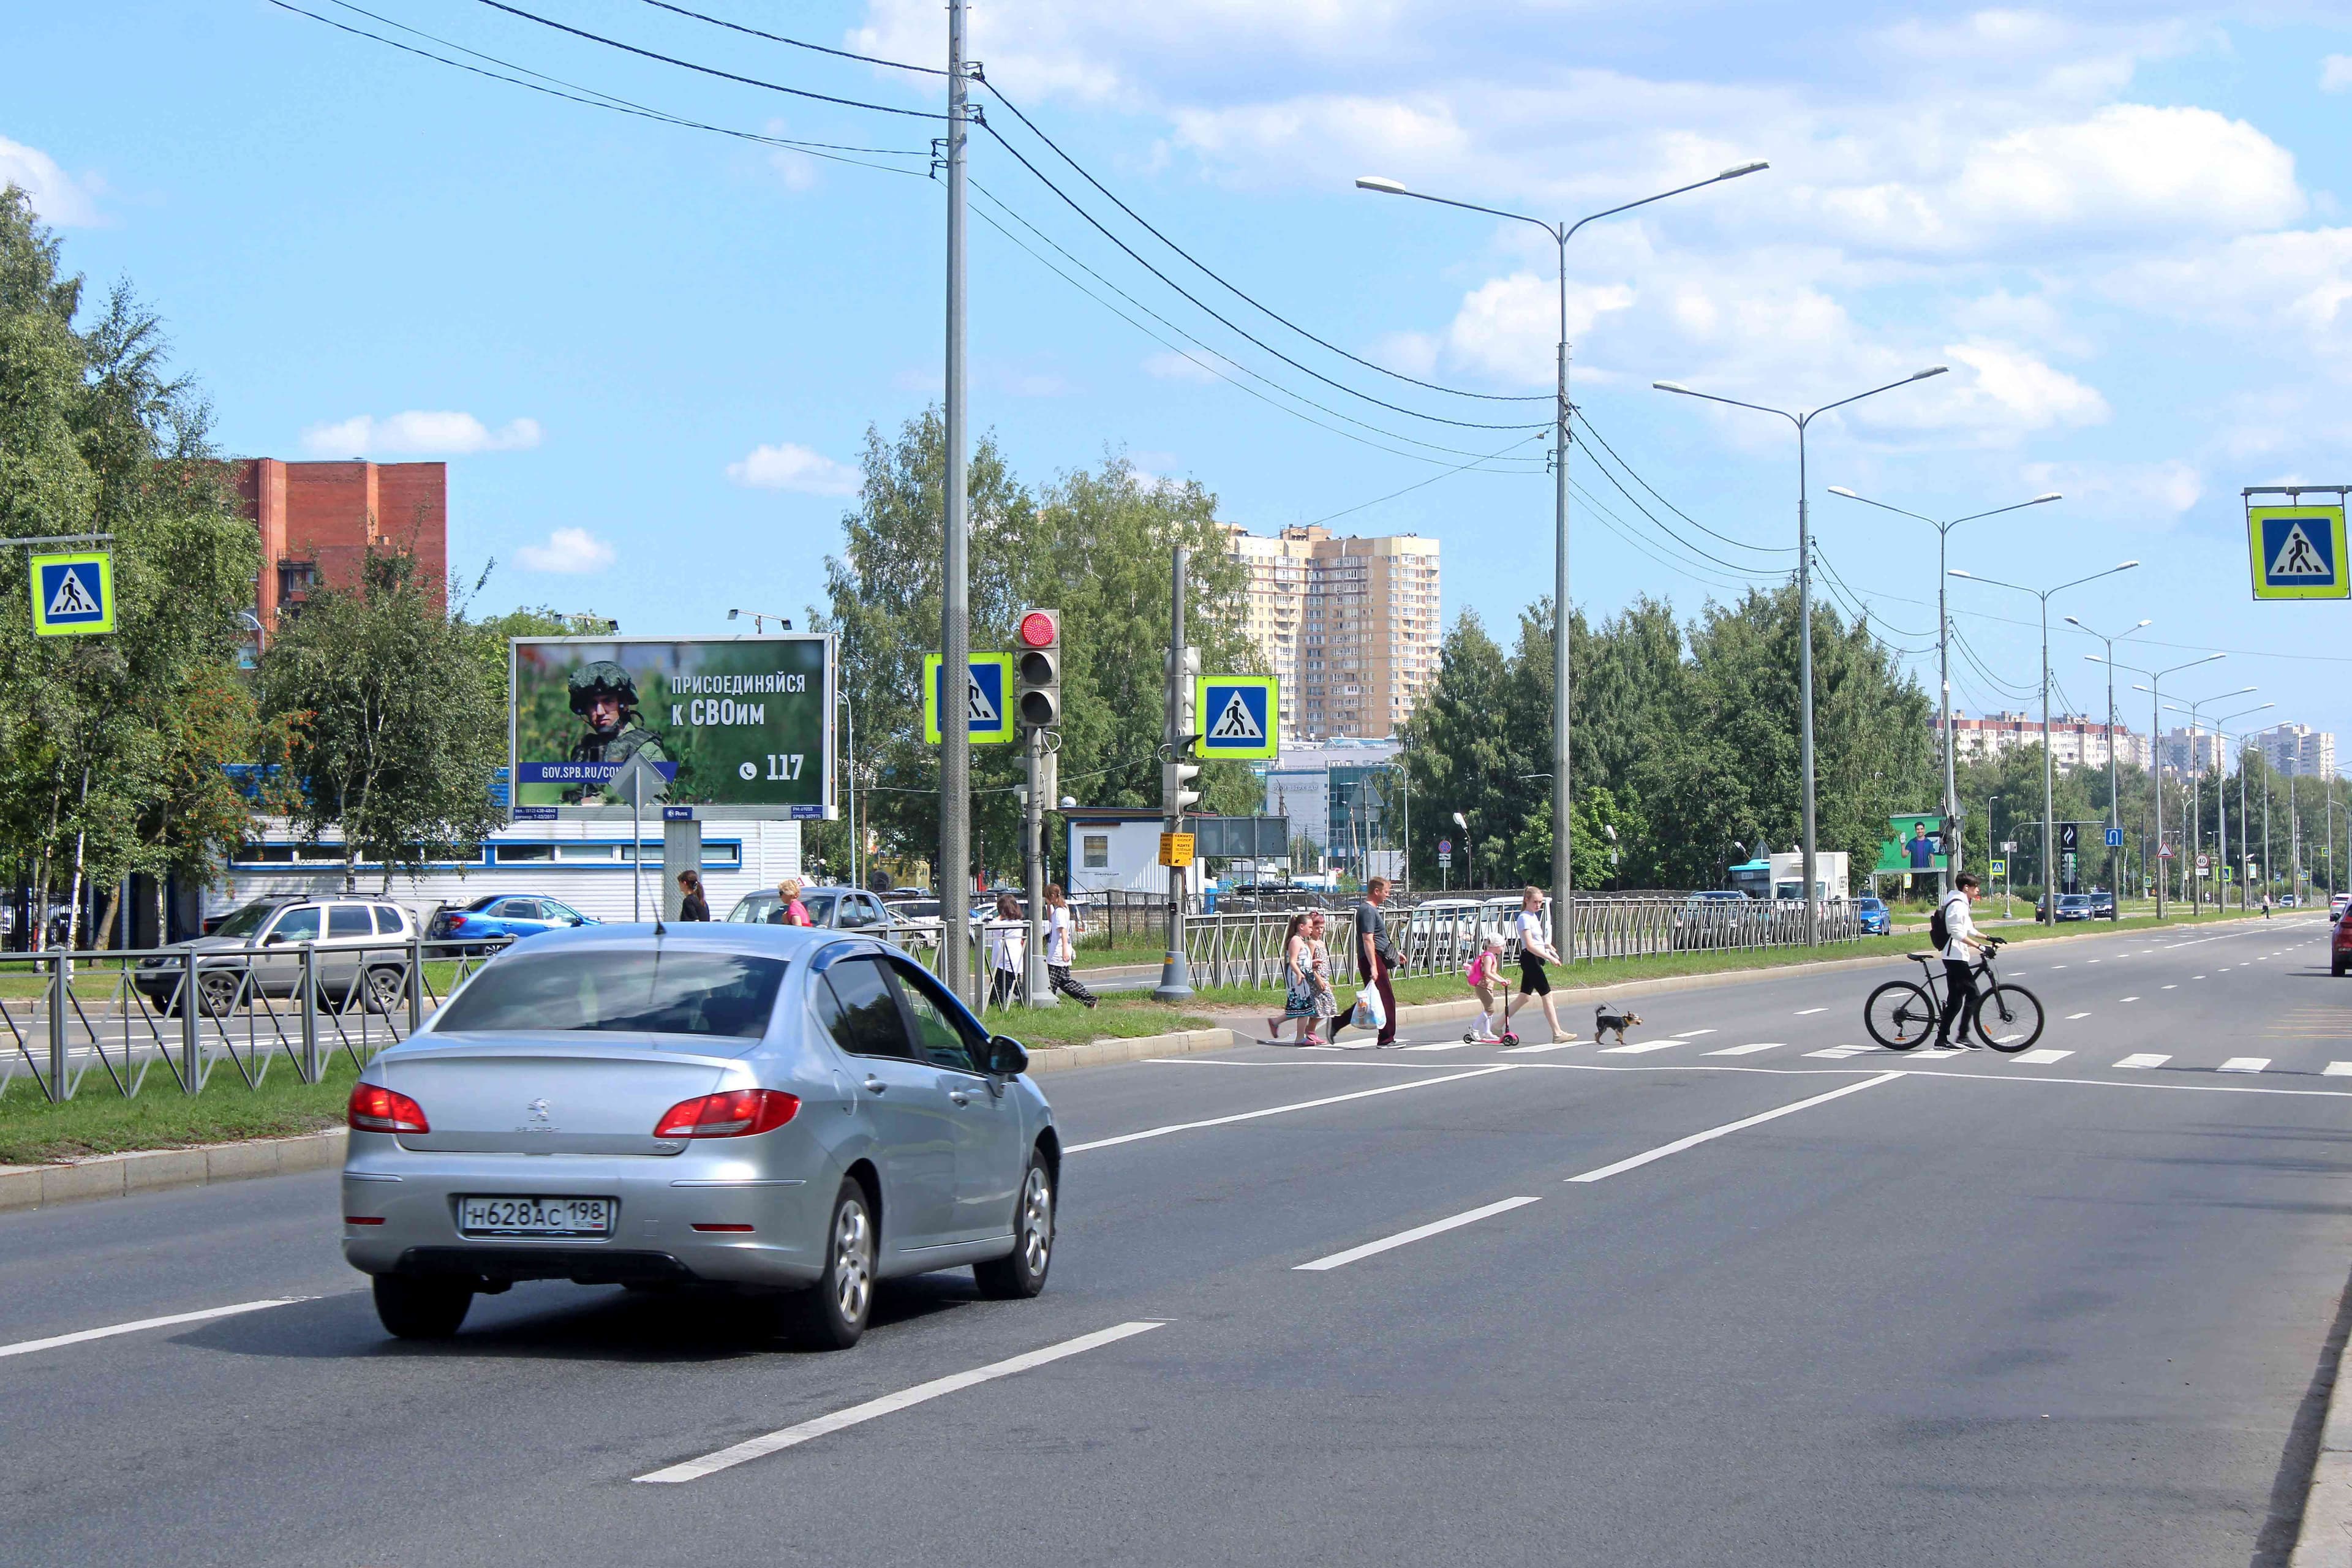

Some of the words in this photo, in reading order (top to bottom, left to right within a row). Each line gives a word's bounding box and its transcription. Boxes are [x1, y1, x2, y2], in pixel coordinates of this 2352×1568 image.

[672, 671, 805, 696] ПРИСОЕДИНЯЙСЯ
[690, 698, 765, 726] СВОим
[766, 754, 804, 780] 117
[567, 1202, 603, 1221] 198
